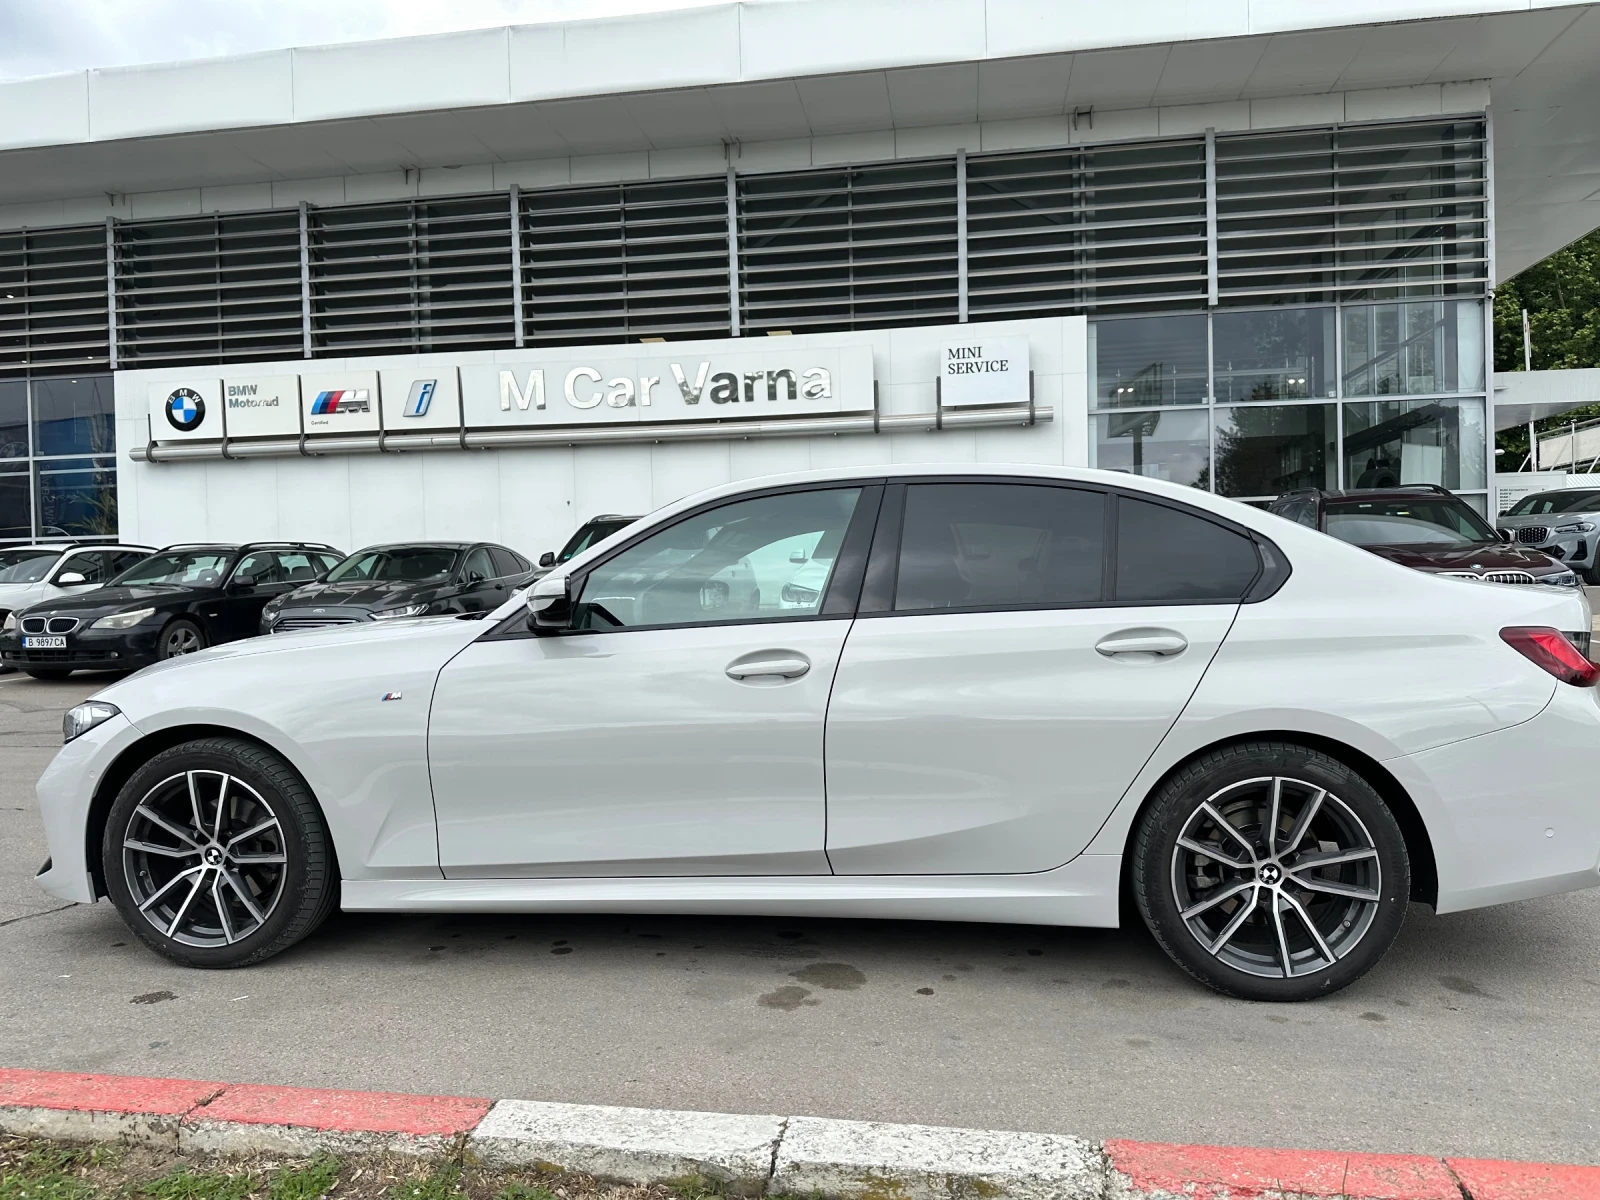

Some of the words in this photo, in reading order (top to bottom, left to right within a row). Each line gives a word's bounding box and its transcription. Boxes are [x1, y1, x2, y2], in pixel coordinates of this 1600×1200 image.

[947, 346, 983, 360] MINI
[947, 359, 1009, 375] SERVICE
[228, 384, 258, 397] BMW
[499, 369, 546, 412] M
[563, 366, 661, 410] Car
[669, 361, 832, 405] Varna
[168, 389, 201, 404] BMW
[229, 396, 279, 408] Motorrad
[415, 384, 432, 414] i
